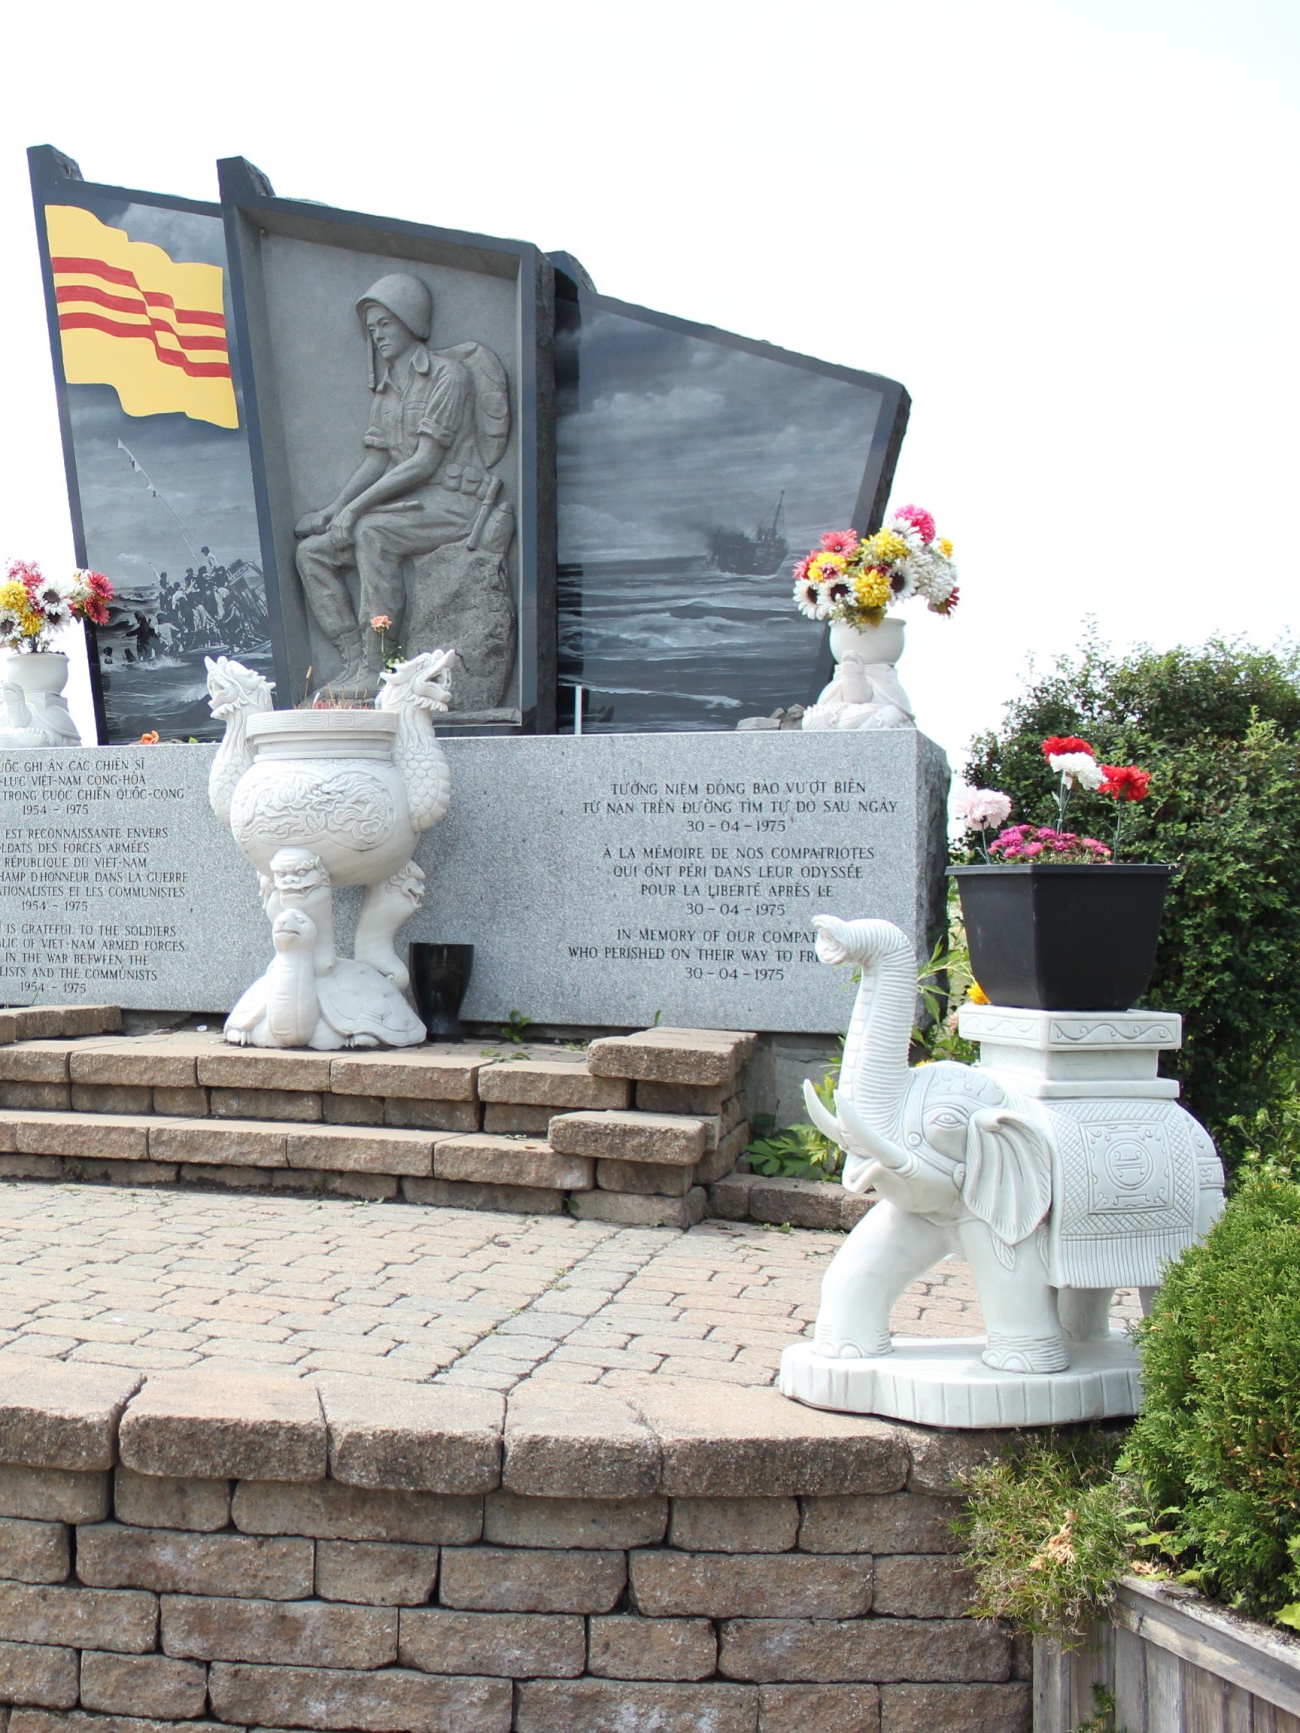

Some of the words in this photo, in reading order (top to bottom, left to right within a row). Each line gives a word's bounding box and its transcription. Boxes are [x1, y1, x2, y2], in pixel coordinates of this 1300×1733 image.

[24, 762, 42, 772] GHI
[3, 791, 37, 801] TRONG
[23, 805, 46, 815] 1954
[66, 805, 89, 815] 1975
[797, 801, 816, 813] DO
[823, 801, 850, 813] SAU
[687, 820, 704, 832] 30
[721, 820, 740, 832] 04
[757, 820, 785, 832] 1975
[6, 829, 22, 839] EST
[28, 828, 121, 839] RECONNAISSANTE
[127, 828, 168, 838] ENVERS
[38, 843, 58, 853] DES
[64, 843, 101, 853] FORCES
[619, 848, 636, 858] LA
[712, 848, 729, 859] DE
[736, 848, 764, 859] NOS
[771, 847, 874, 860] COMPATRIOTES
[74, 857, 89, 867] DU
[95, 872, 123, 882] DANS
[129, 872, 142, 882] LA
[147, 872, 188, 883] GUERRE
[614, 866, 637, 878] QUI
[715, 866, 751, 878] DANS
[759, 866, 793, 878] LEUR
[70, 886, 79, 897] ET
[86, 886, 103, 897] LES
[109, 886, 185, 898] COMMUNISTES
[641, 884, 675, 896] POUR
[684, 885, 700, 896] LA
[818, 885, 833, 897] LE
[22, 900, 46, 911] 1954
[65, 901, 88, 911] 1975
[686, 903, 703, 915] 30
[720, 903, 739, 915] 04
[756, 903, 785, 915] 1975
[7, 924, 15, 934] IS
[22, 924, 74, 935] GRATEFUL
[80, 925, 93, 935] TO
[99, 925, 119, 936] THE
[125, 925, 176, 936] SOLDIERS
[617, 929, 630, 940] IN
[639, 929, 695, 942] MEMORY
[704, 930, 719, 943] OF
[727, 930, 755, 943] OUR
[763, 931, 819, 944] COMPAT
[24, 938, 36, 948] OF
[102, 940, 138, 950] ARMED
[145, 940, 185, 951] FORCES
[6, 952, 16, 962] IN
[22, 952, 42, 963] THE
[47, 953, 68, 963] WAR
[74, 954, 122, 965] BETWEEN
[128, 955, 149, 965] THE
[569, 947, 597, 959] WHO
[604, 947, 665, 960] PERISHED
[671, 948, 690, 960] ON
[698, 948, 734, 961] THEIR
[742, 949, 768, 962] WAY
[775, 950, 793, 962] TO
[32, 967, 54, 978] AND
[60, 968, 79, 978] THE
[85, 968, 157, 981] COMMUNISTS
[685, 967, 703, 980] 30
[719, 968, 738, 980] 04
[755, 968, 784, 980] 1975
[20, 982, 45, 992] 1954
[64, 982, 86, 993] 1975
